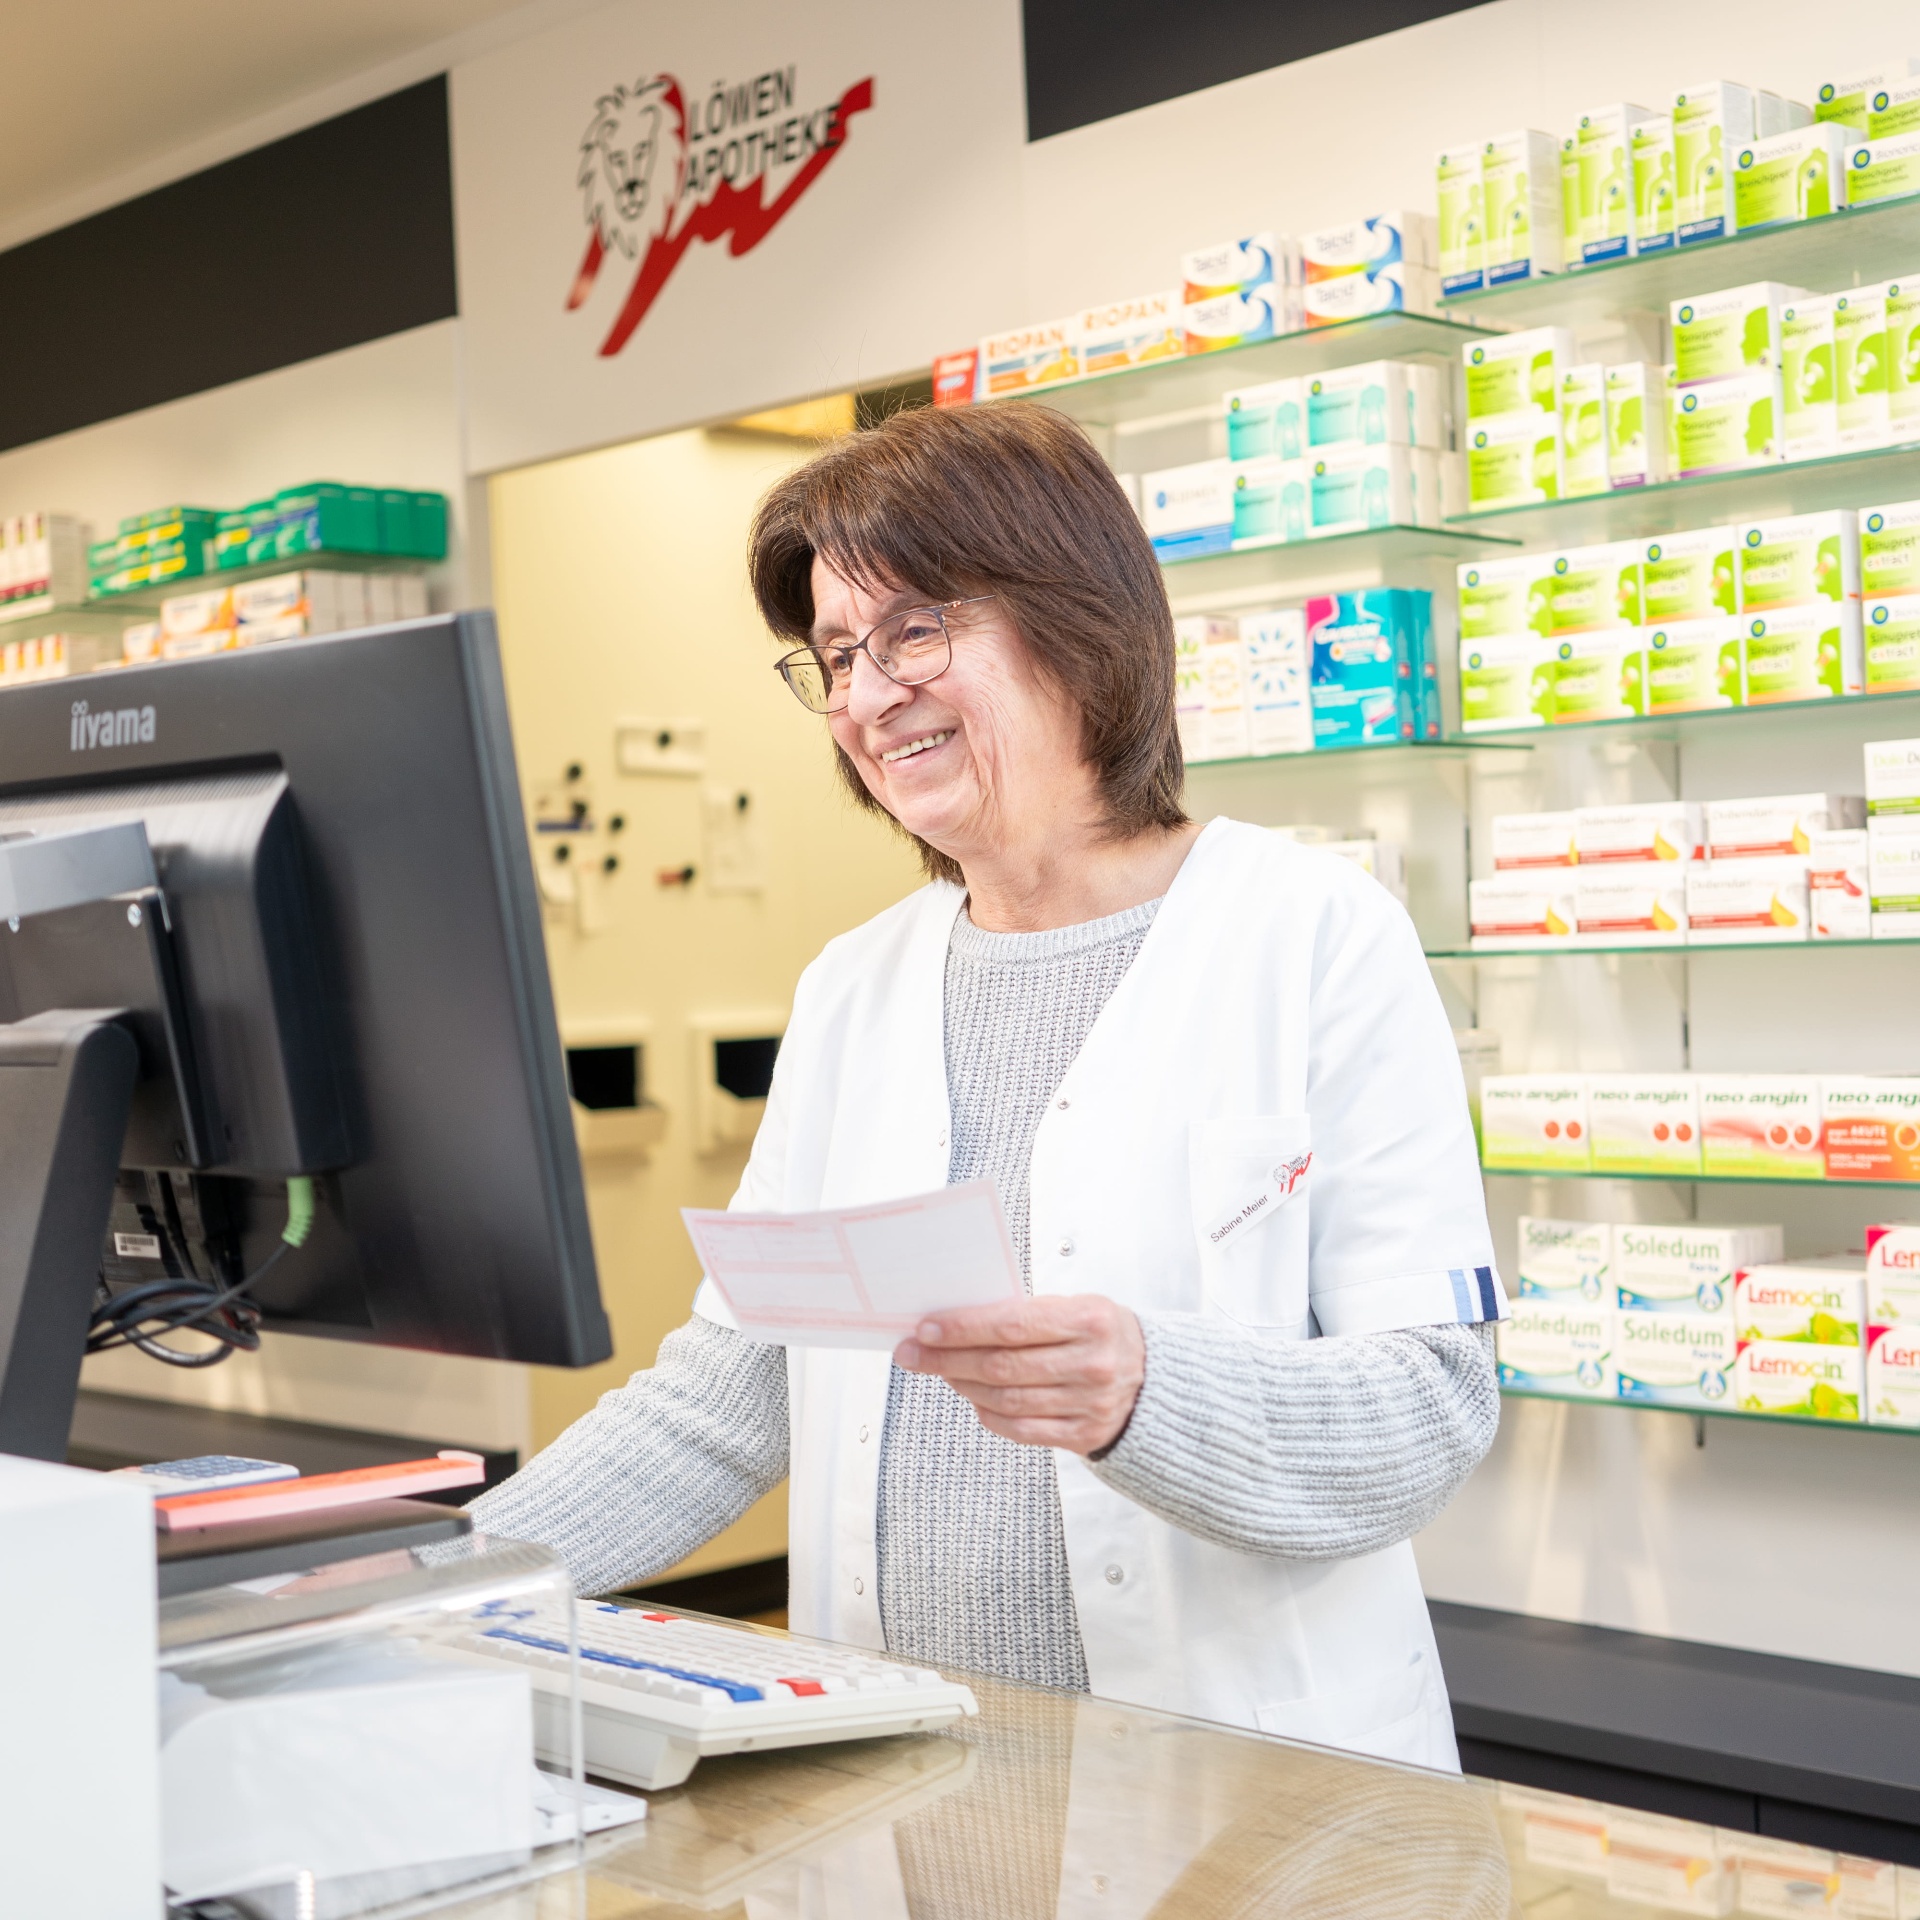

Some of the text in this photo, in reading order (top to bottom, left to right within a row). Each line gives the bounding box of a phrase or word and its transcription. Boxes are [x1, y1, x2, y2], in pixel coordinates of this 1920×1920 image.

[690, 64, 796, 142] LÖWEN
[681, 103, 841, 197] APOTHEKE
[1084, 299, 1168, 331] RIOPAN
[987, 326, 1065, 359] RIOPAN
[1865, 535, 1915, 552] Sinupret
[70, 699, 156, 752] iiyama
[1487, 1088, 1579, 1103] neo angin
[1593, 1089, 1688, 1104] neo angin
[1705, 1089, 1809, 1106] neo angin
[1828, 1092, 1920, 1108] neo ang
[1210, 1194, 1269, 1243] Sabine Meier
[1525, 1221, 1600, 1249] Soledum
[1622, 1232, 1721, 1260] Soledum
[1748, 1283, 1842, 1310] Lemocin
[1508, 1308, 1601, 1337] Soledum
[1623, 1317, 1725, 1347] Soledum
[1749, 1352, 1843, 1380] Lemocin
